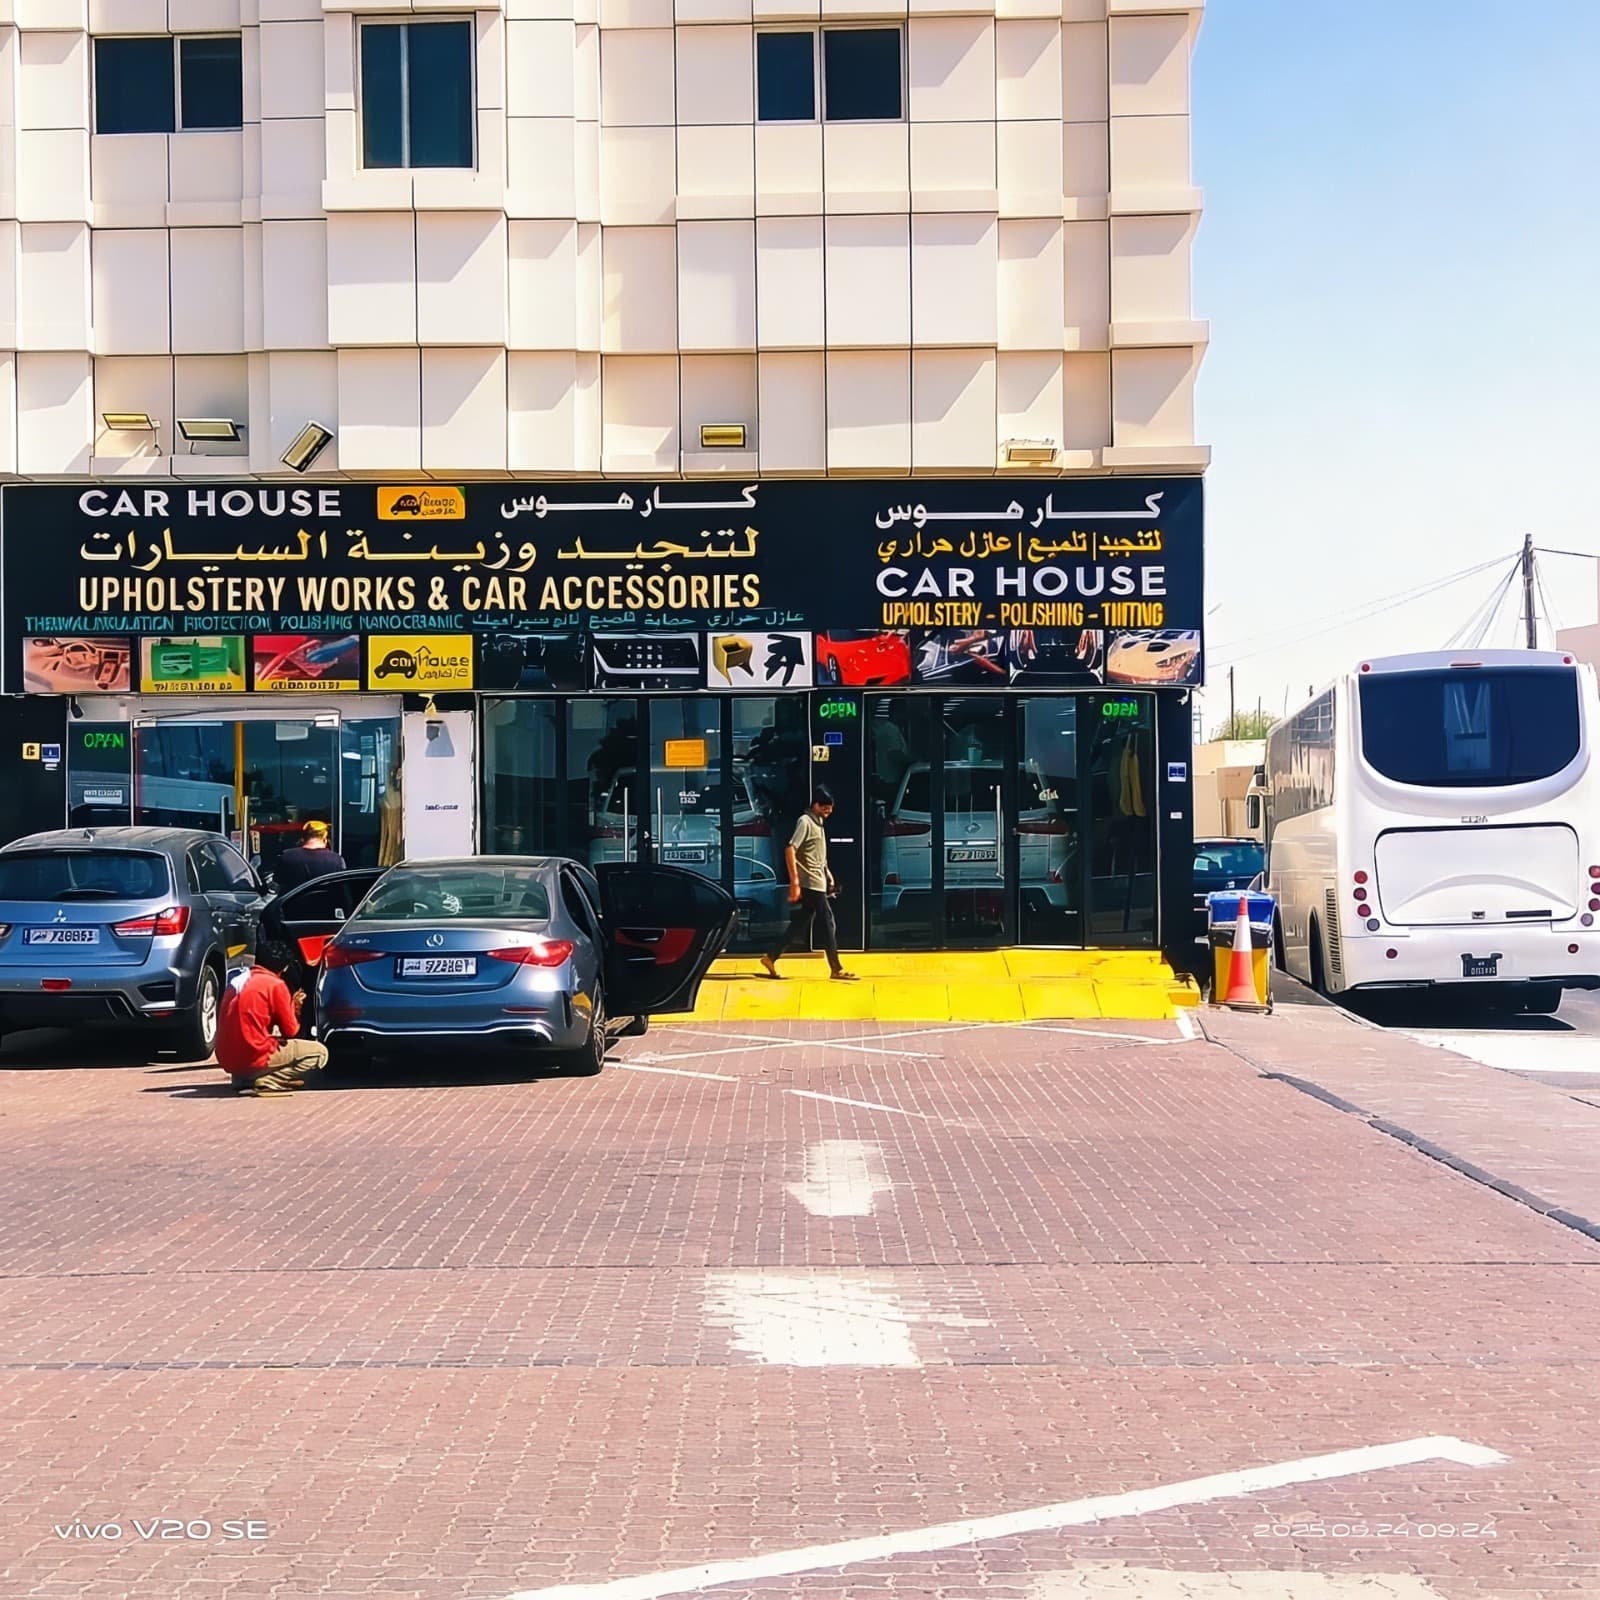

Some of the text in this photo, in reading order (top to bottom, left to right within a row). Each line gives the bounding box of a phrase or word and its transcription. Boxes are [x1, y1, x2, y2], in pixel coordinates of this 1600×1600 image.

[79, 490, 341, 517] CAR HOUSE
[500, 484, 759, 519] كار هوس
[875, 491, 1164, 528] كار هوس
[80, 526, 760, 571] لتنجيد وزينة السيارات
[79, 574, 761, 612] UPHOLSTERY WORKS & CAR ACCESSORIES
[876, 566, 1166, 597] CAR HOUSE
[882, 602, 983, 626] UPHOLSTERY
[1000, 602, 1084, 626] POLISHING
